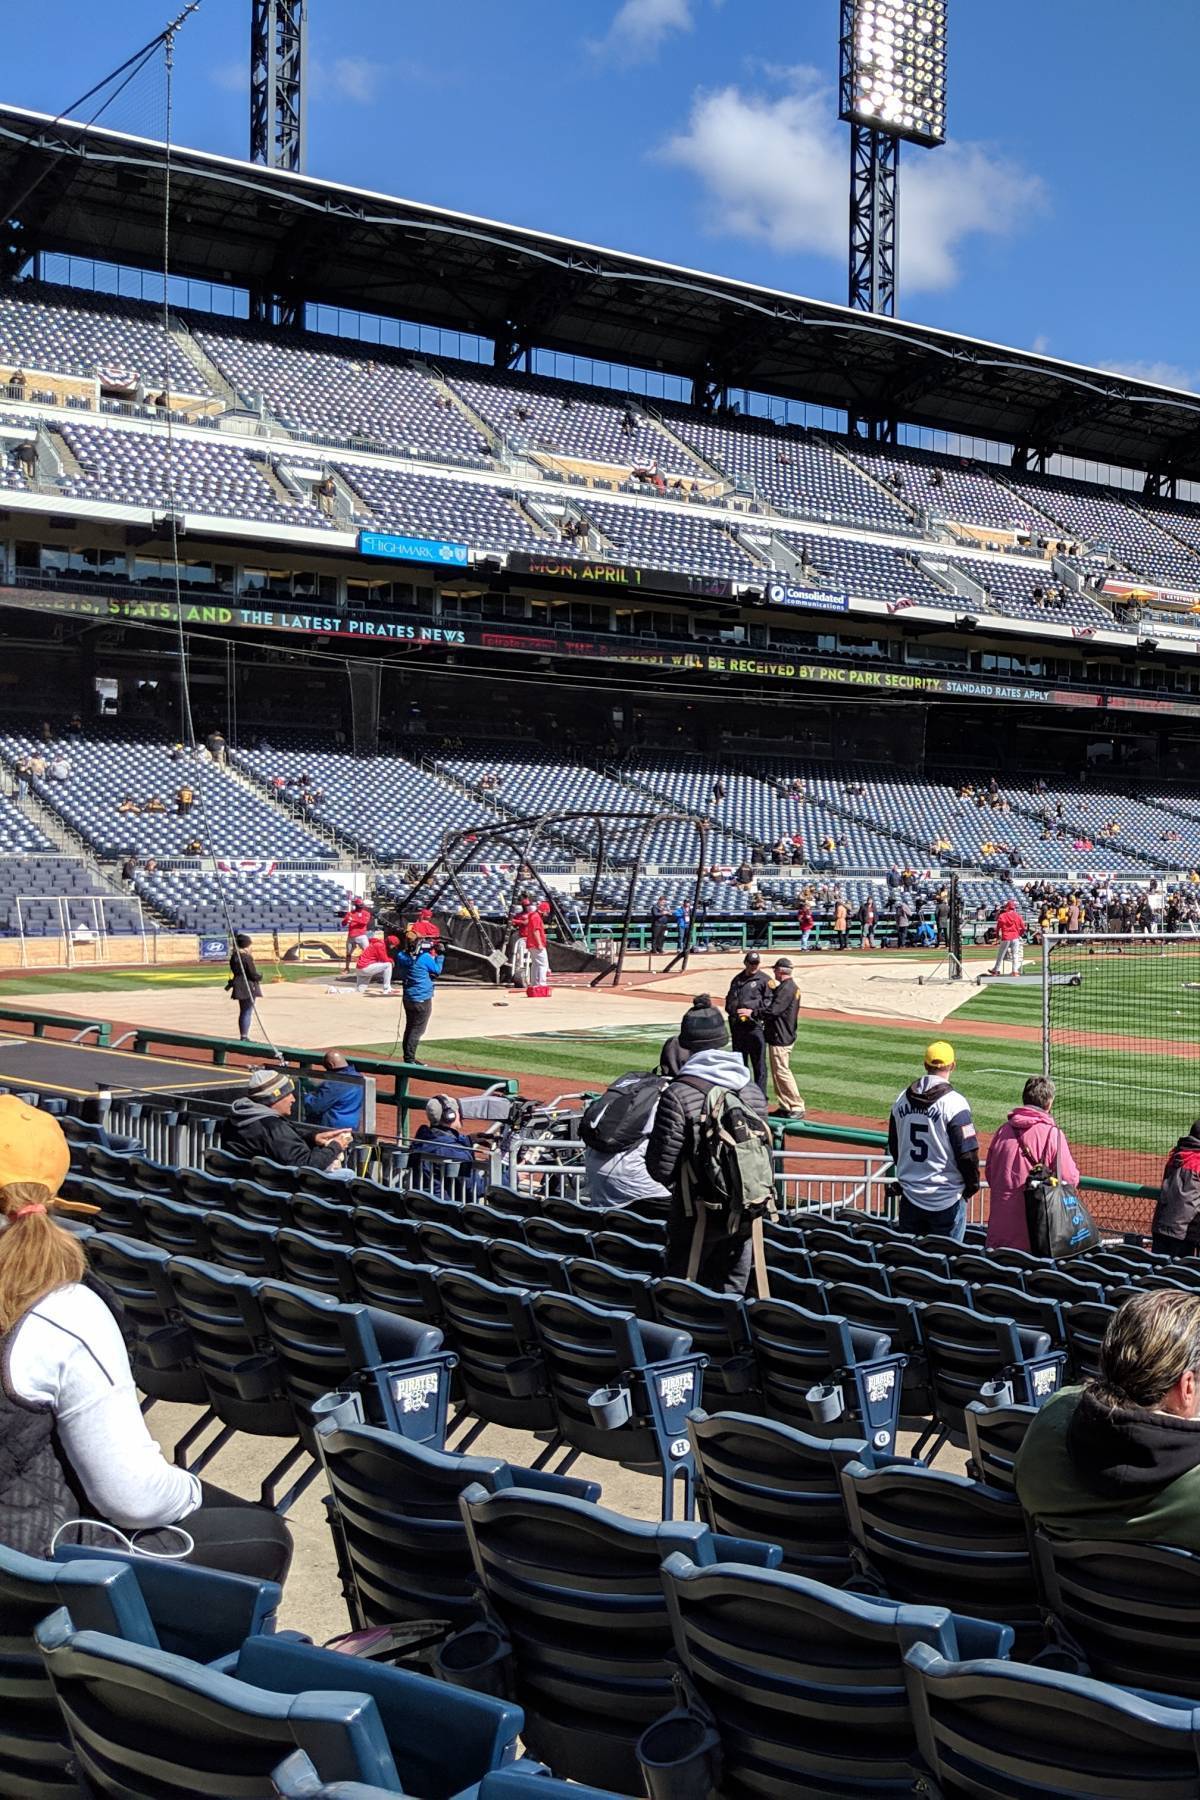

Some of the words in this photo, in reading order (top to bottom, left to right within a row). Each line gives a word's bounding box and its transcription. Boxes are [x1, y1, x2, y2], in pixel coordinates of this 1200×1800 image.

[364, 537, 434, 559] HIGHMARK
[529, 558, 577, 579] MON,
[582, 566, 628, 584] APRIL
[635, 570, 641, 585] 1
[787, 588, 845, 605] Consolidated
[787, 599, 844, 611] communications
[187, 607, 232, 624] AND
[241, 610, 273, 626] THE
[281, 614, 342, 632] LATEST
[349, 620, 415, 638] PIRATES
[421, 628, 466, 644] NEWS
[708, 656, 726, 670] BE
[730, 657, 795, 676] RECEIVED
[799, 665, 815, 678] BY
[819, 669, 846, 682] PNC
[849, 671, 881, 685] PARK
[884, 676, 943, 691] SECURITY.
[946, 681, 993, 696] STANDARD
[995, 687, 1021, 698] RATES
[1023, 690, 1049, 701] APPLY
[910, 1123, 928, 1162] 5
[396, 1373, 438, 1400] PIRATES
[675, 1442, 685, 1453] H
[879, 1433, 886, 1443] G
